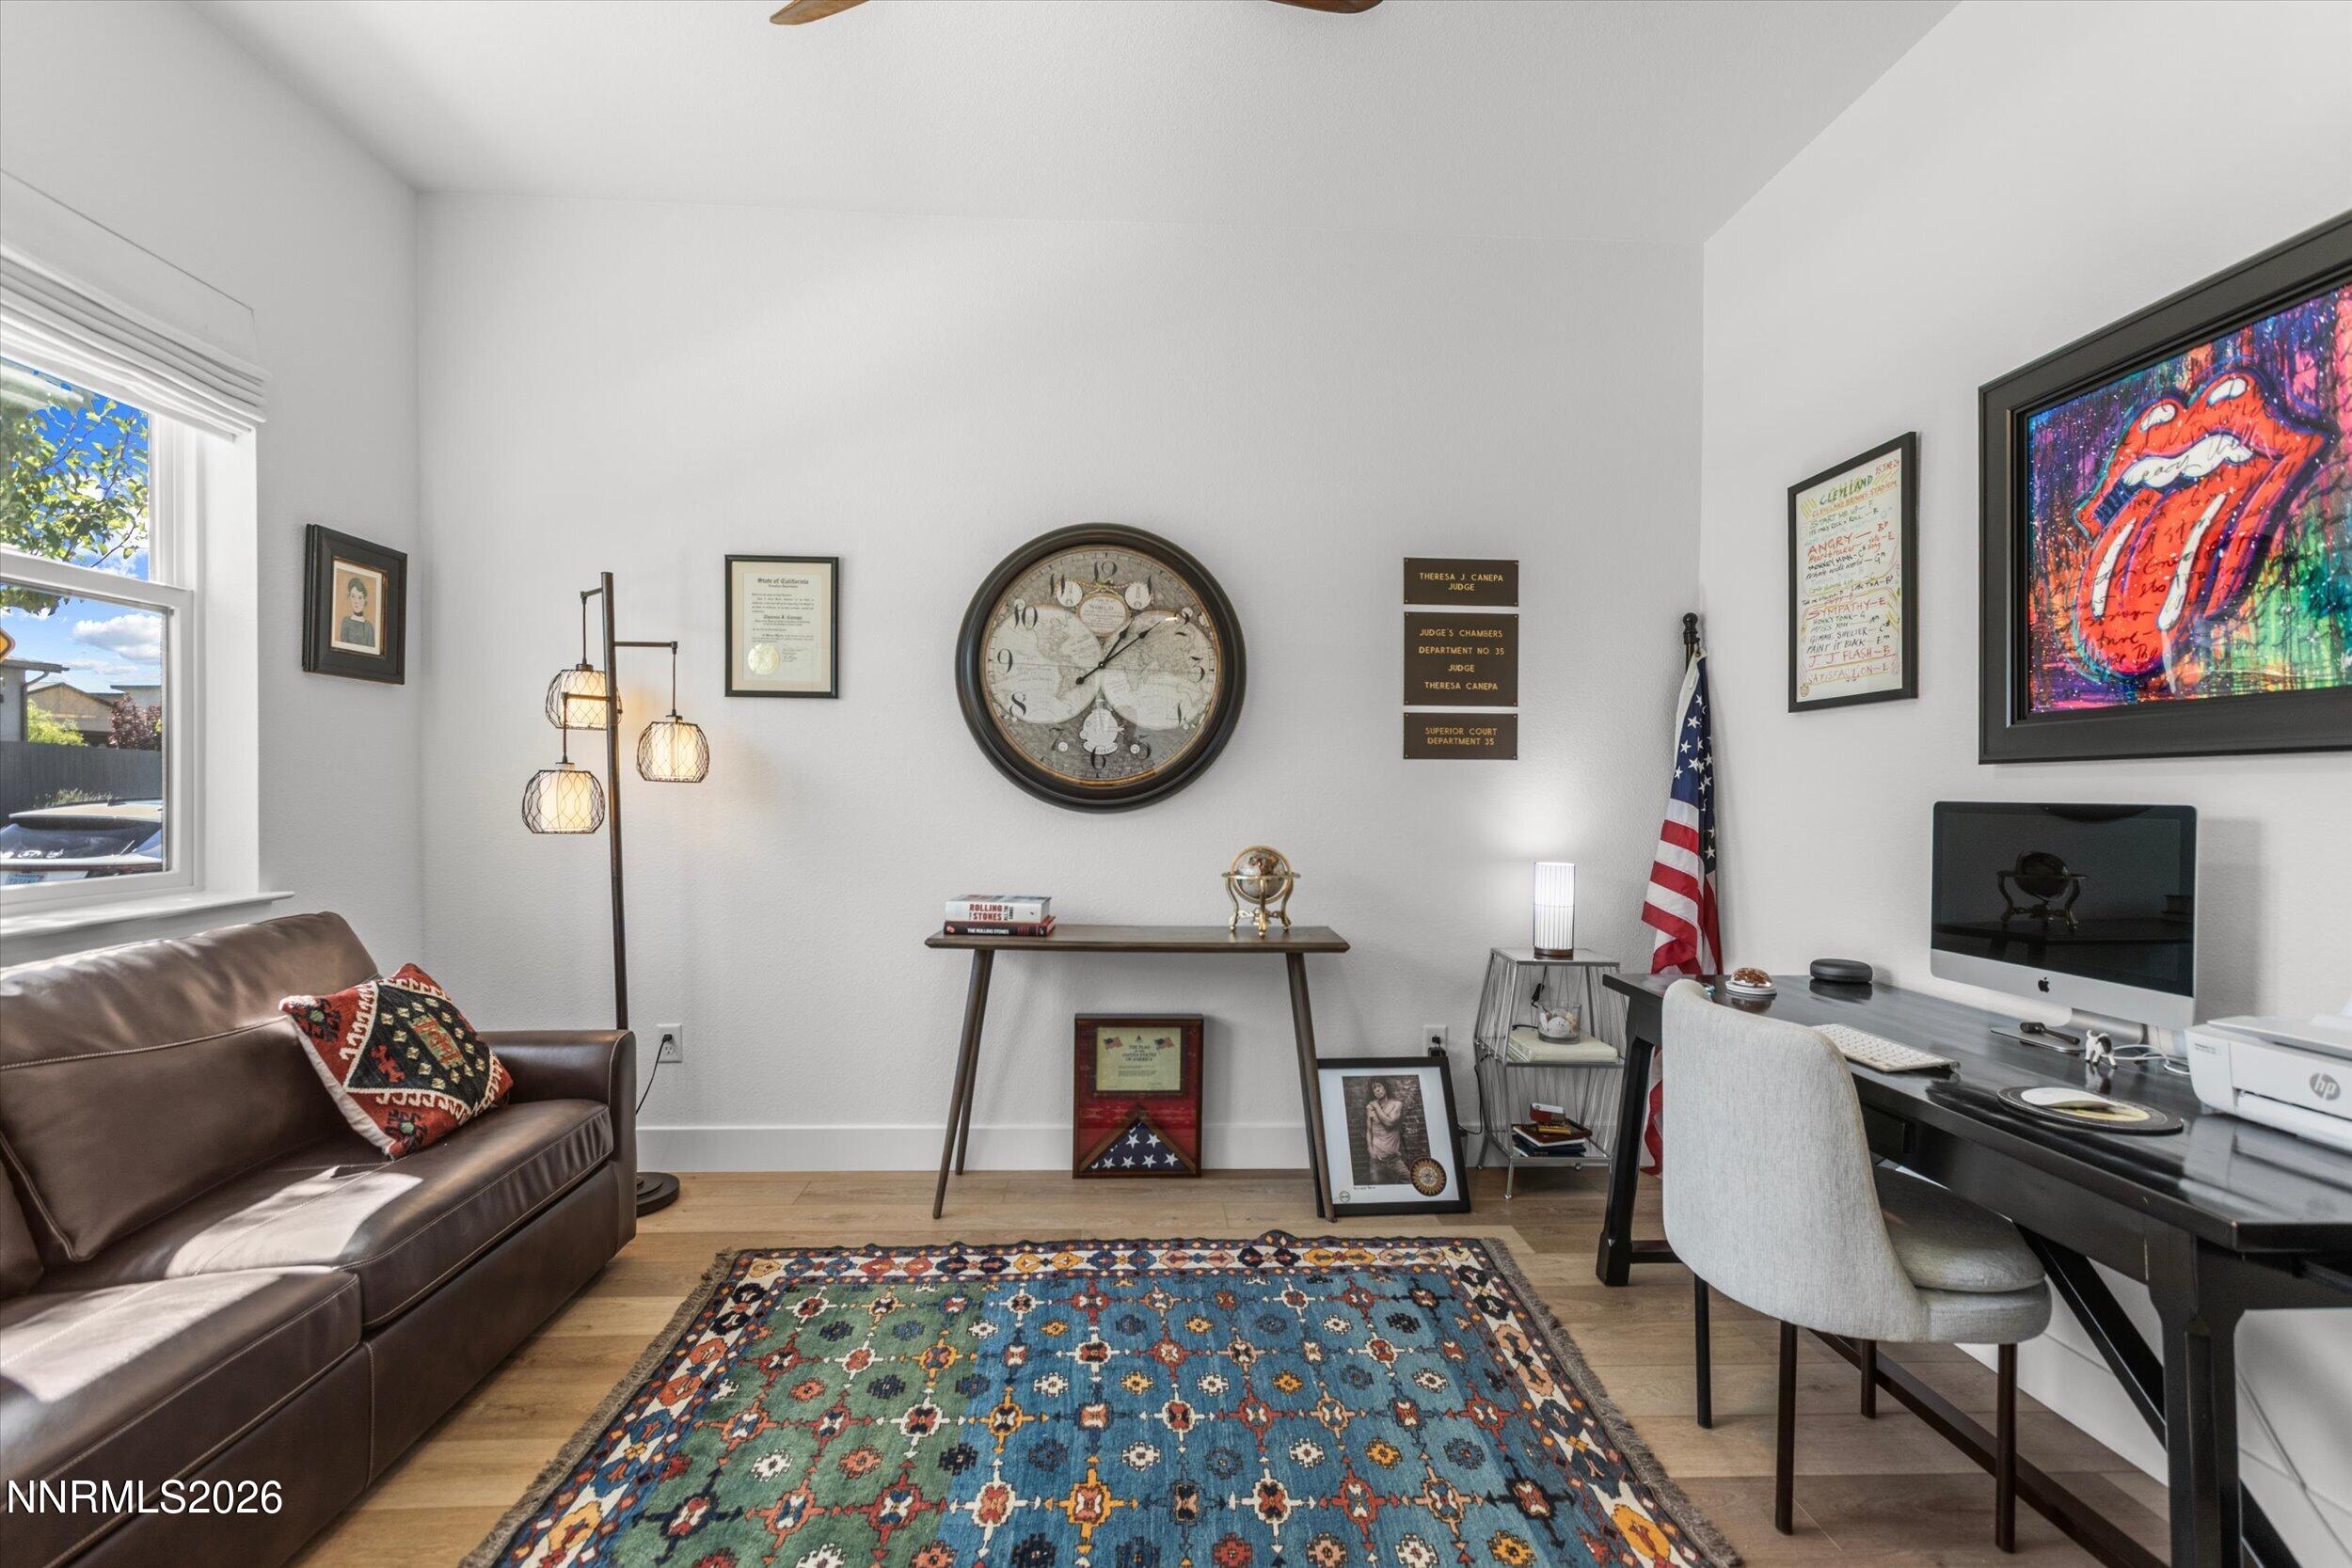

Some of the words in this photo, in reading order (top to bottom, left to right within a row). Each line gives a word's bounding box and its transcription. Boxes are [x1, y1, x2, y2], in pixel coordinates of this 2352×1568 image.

[1808, 533, 1852, 556] ANGRY
[1093, 561, 1118, 583] 12
[1419, 572, 1455, 581] THERESA
[1460, 573, 1465, 581] J
[1470, 574, 1503, 582] CANEPA
[1050, 573, 1066, 597] 11
[1013, 605, 1038, 629] 10
[1806, 599, 1871, 621] SYMPATHY
[1419, 627, 1454, 637] JUDGE'S
[1459, 629, 1503, 638] CHAMBERS
[1418, 646, 1473, 655] DEPARTMENT
[1495, 647, 1505, 656] 35
[1806, 642, 1830, 654] PAINT
[1843, 647, 1872, 661] FLASH
[997, 648, 1013, 674] 9
[1188, 656, 1205, 683] 3
[1448, 664, 1475, 673] JUDGE
[1423, 681, 1461, 689] THERESA
[1466, 682, 1498, 690] CANEPA
[1009, 691, 1026, 716] 8
[1424, 727, 1464, 736] SUPERIOR
[1136, 734, 1152, 760] 5
[1427, 737, 1481, 746] DEPARTMENT
[1485, 737, 1495, 746] 35
[1091, 747, 1106, 770] 6
[969, 903, 1002, 911] ROLLING
[973, 912, 1002, 921] STONES
[2312, 1073, 2338, 1101] hp
